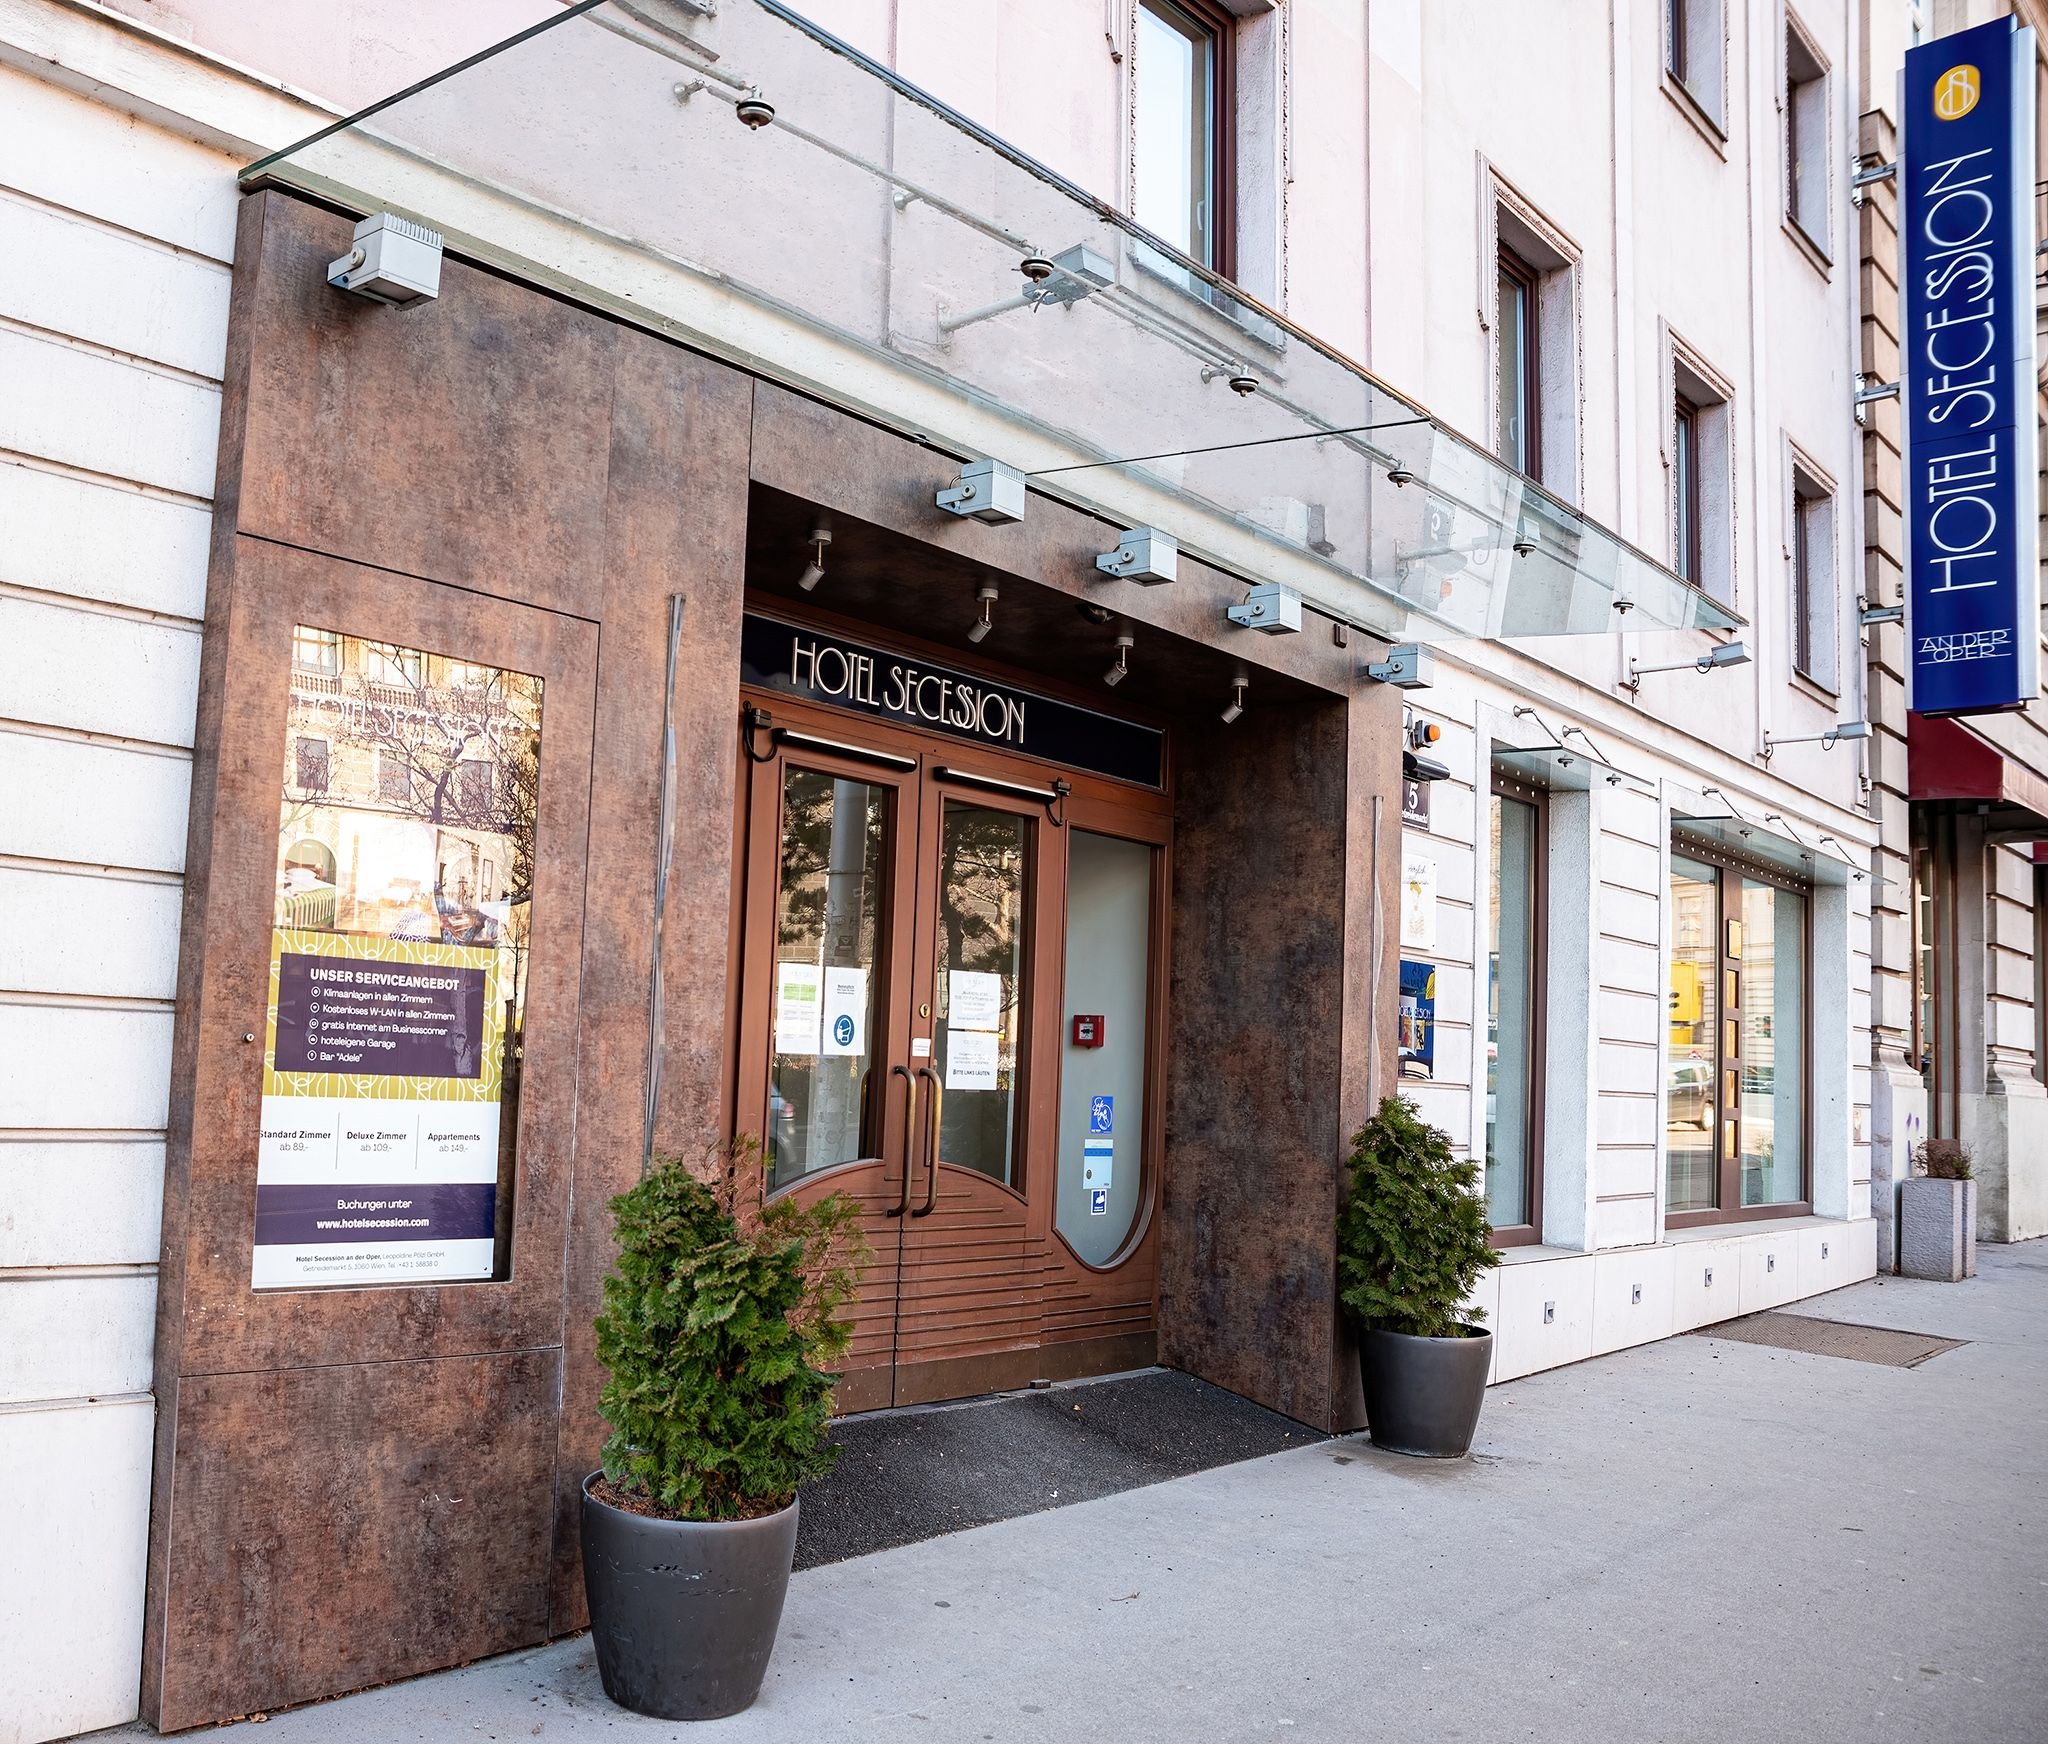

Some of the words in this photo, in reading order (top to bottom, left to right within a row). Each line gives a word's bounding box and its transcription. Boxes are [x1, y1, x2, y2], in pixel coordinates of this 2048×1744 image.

[1922, 147, 1996, 428] SECESSION
[1928, 433, 1998, 593] HOTEL
[1920, 635, 1955, 652] AN
[1962, 629, 2009, 648] DER
[1932, 644, 1997, 663] OPER
[790, 636, 880, 706] HOTEL
[882, 665, 1026, 744] SECESSION
[298, 695, 370, 734] HOTEL
[374, 704, 503, 757] SECESSION
[1408, 781, 1419, 810] 5
[310, 968, 354, 982] UNSER
[355, 972, 460, 991] SERVICEANGEBOT
[323, 988, 374, 1001] Klimaanlagen
[374, 991, 382, 1000] in
[382, 992, 400, 1002] allen
[400, 994, 433, 1004] Zimmern
[322, 1004, 368, 1016] Kostenloses
[369, 1007, 397, 1017] W-LAN
[397, 1009, 405, 1018] in
[405, 1009, 422, 1019] allen
[423, 1010, 455, 1021] Zimmern
[321, 1020, 345, 1031] gratis
[346, 1021, 378, 1032] Internet
[378, 1024, 391, 1033] am
[392, 1024, 448, 1036] Businesscorner
[320, 1036, 366, 1048] hoteleigene
[366, 1038, 397, 1051] Garage
[320, 1051, 336, 1061] Bar
[259, 1130, 297, 1139] Standard
[299, 1130, 331, 1139] Zimmer
[346, 1131, 375, 1140] Deluxe
[376, 1131, 407, 1140] Zimmer
[427, 1132, 481, 1142] Appartements
[279, 1142, 291, 1151] ab
[359, 1143, 371, 1152] ab
[438, 1144, 450, 1152] ab
[337, 1199, 387, 1211] Buchungen
[388, 1199, 413, 1209] unter
[316, 1217, 430, 1229] www.hotelsecession.com
[295, 1255, 313, 1263] Hotel
[314, 1254, 345, 1262] Secession
